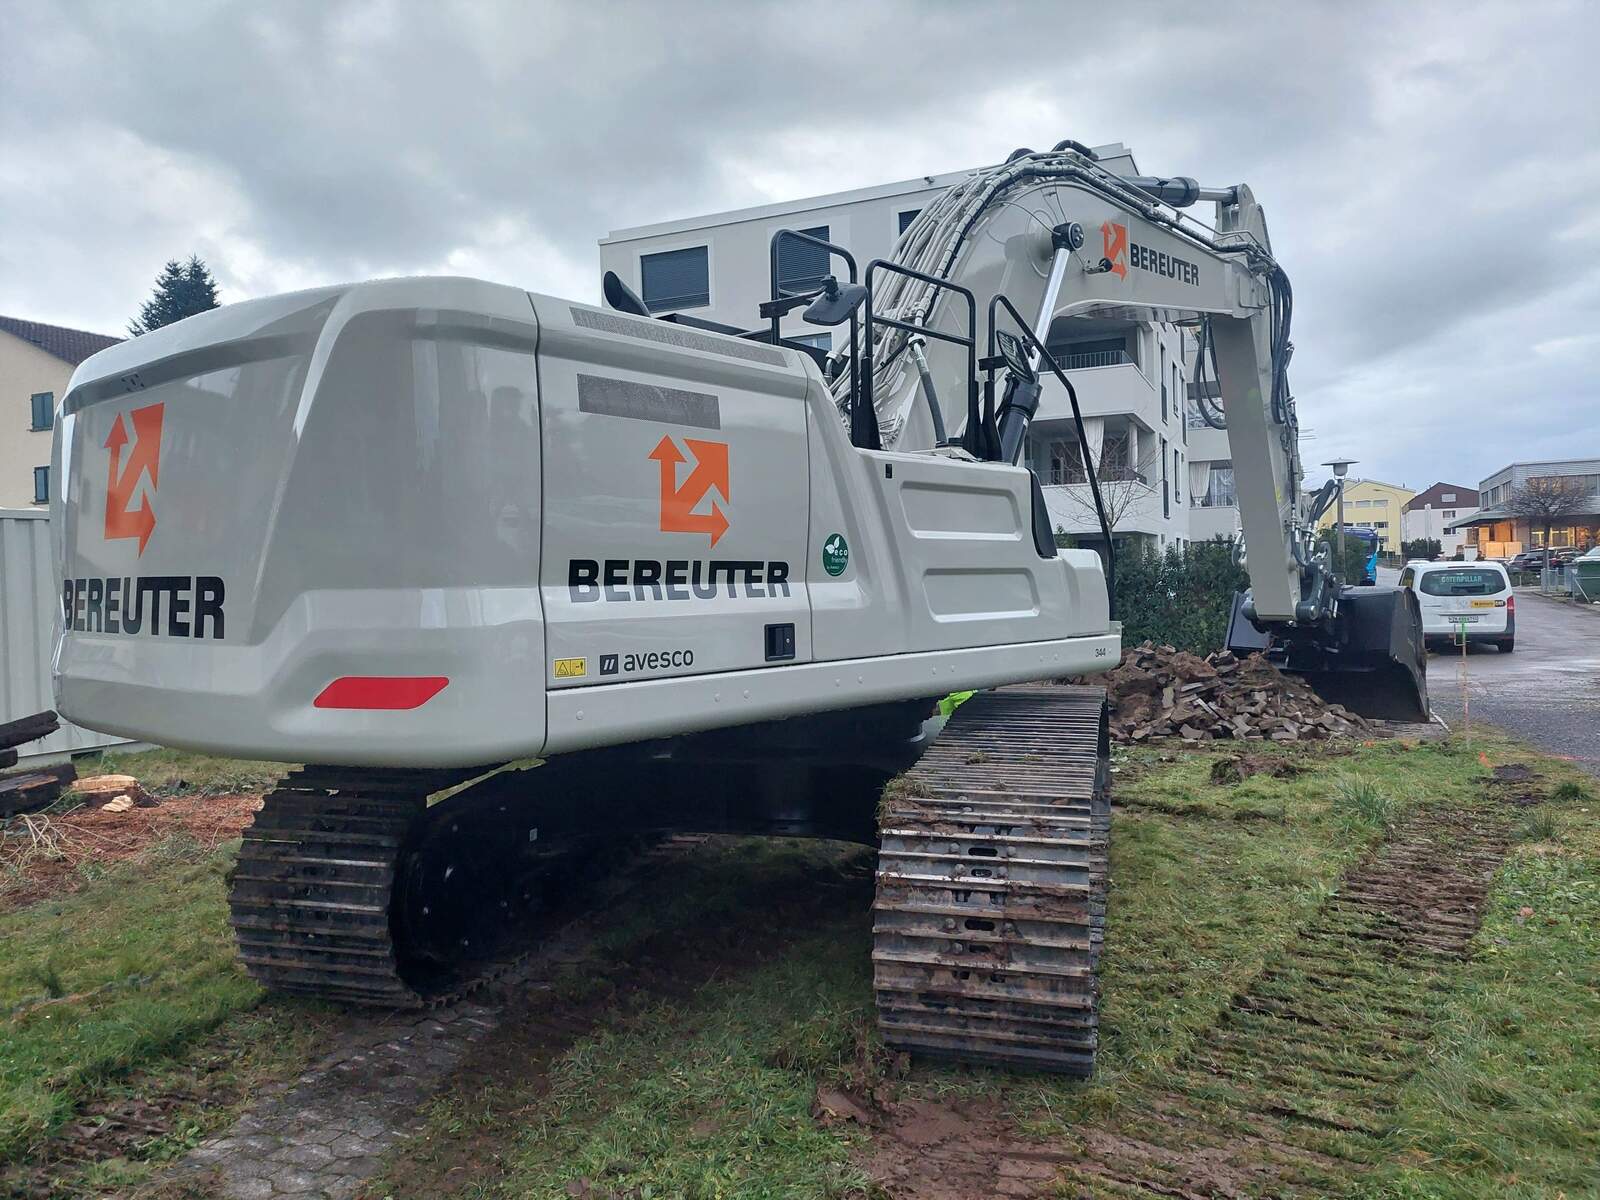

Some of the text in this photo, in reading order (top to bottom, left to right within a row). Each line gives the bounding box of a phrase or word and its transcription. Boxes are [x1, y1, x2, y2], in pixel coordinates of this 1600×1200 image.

[1130, 243, 1199, 286] BEREUTER
[568, 559, 790, 602] BEREUTER
[64, 576, 225, 639] BEREUTER
[623, 650, 694, 671] avesco
